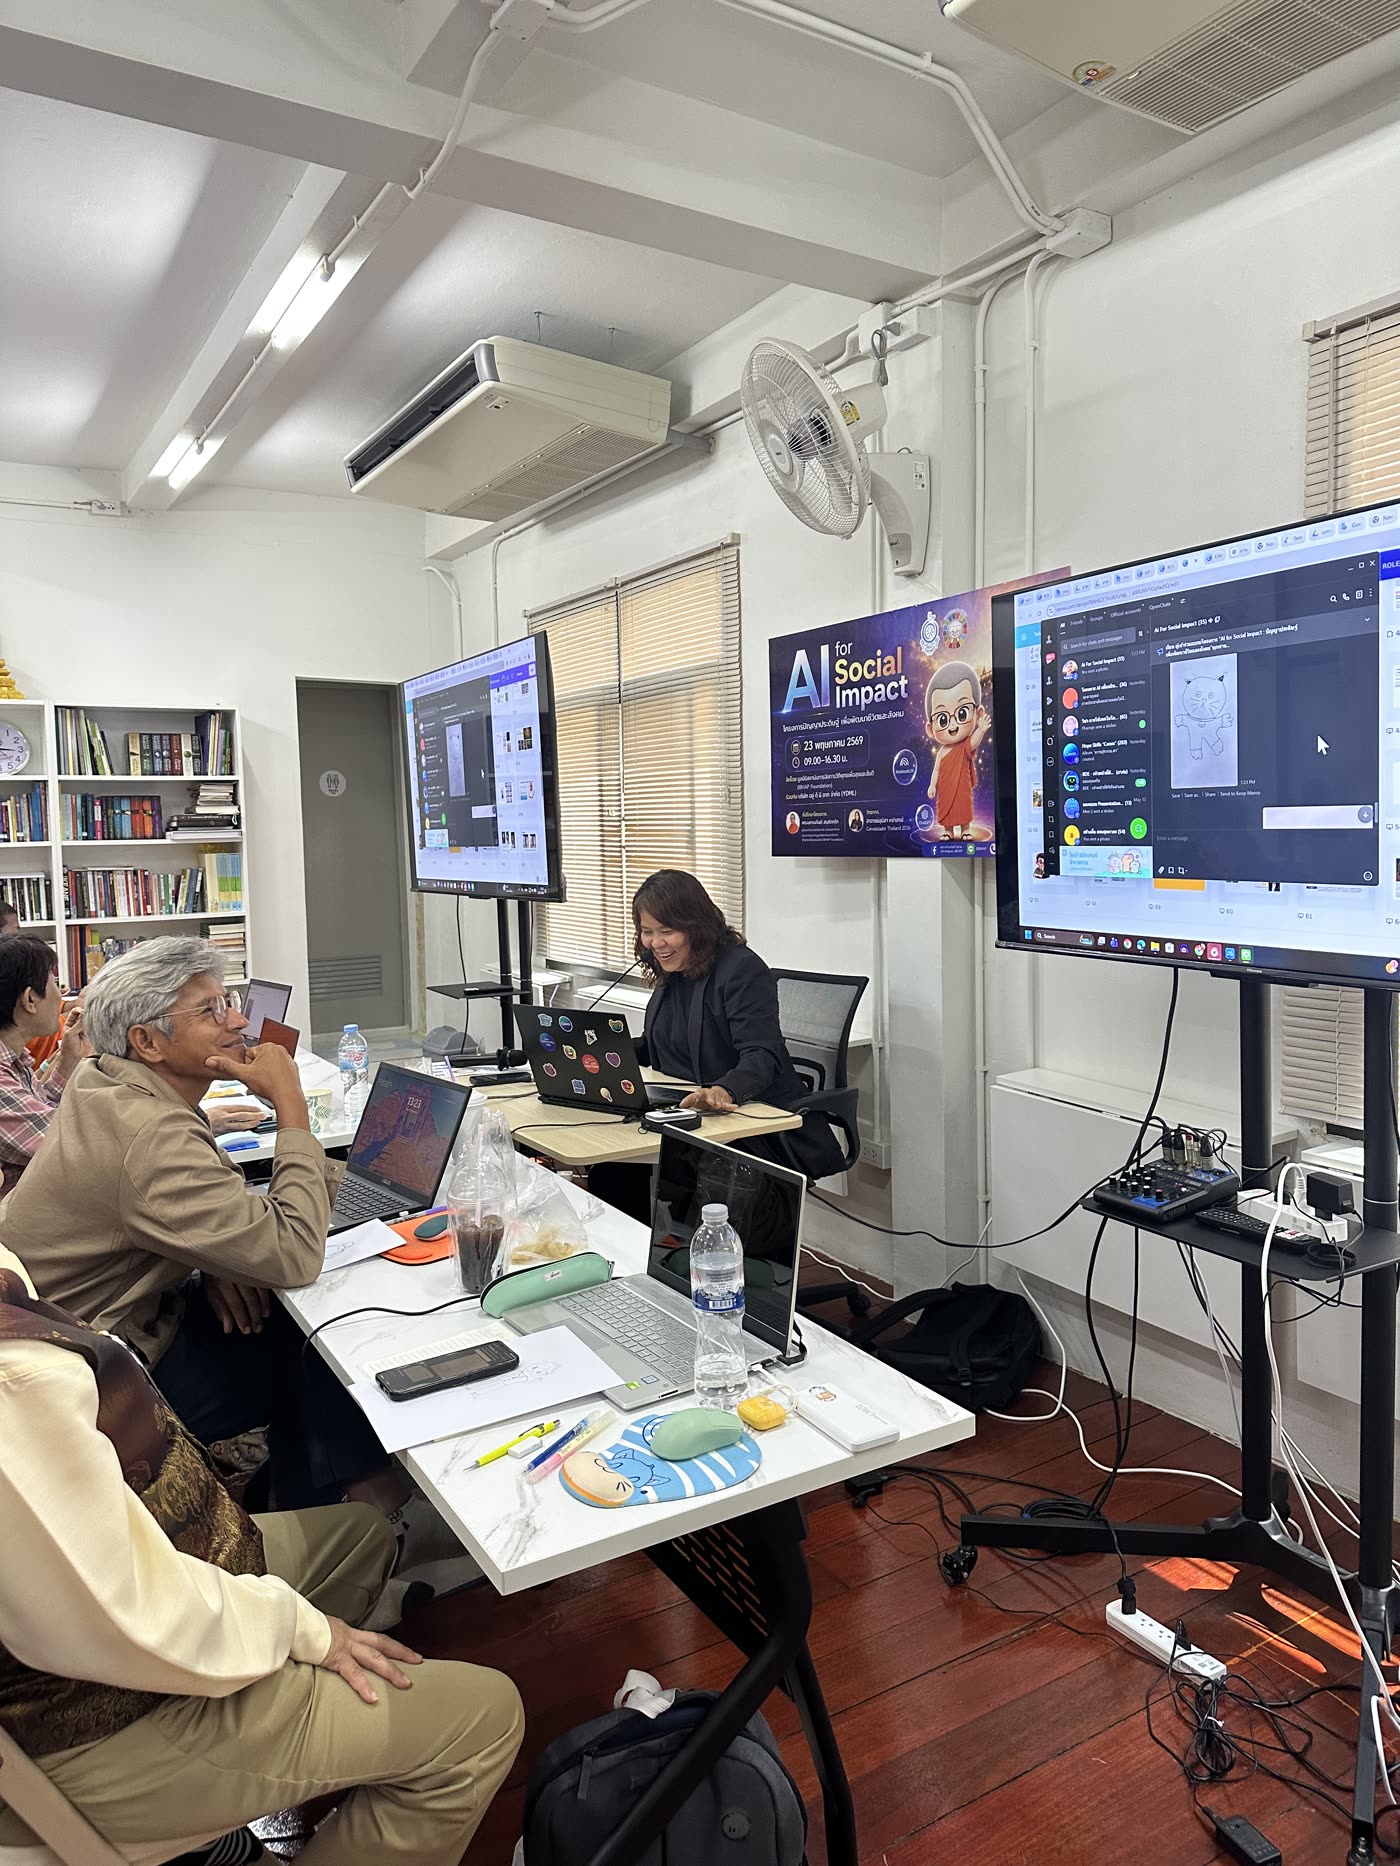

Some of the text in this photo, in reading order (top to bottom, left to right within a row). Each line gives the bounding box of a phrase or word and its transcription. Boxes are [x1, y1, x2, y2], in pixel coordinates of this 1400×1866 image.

[1168, 622, 1181, 631] Social
[1181, 620, 1197, 630] Impact
[1233, 632, 1246, 640] Social
[1247, 629, 1262, 638] Impact
[835, 641, 853, 657] for
[835, 646, 902, 685] Social
[783, 644, 830, 713] AI
[836, 675, 908, 711] Impact
[13, 736, 20, 744] 2
[803, 735, 864, 751] 23 พฤษภาคม 2569
[18, 745, 24, 754] 3
[7, 761, 14, 769] 5
